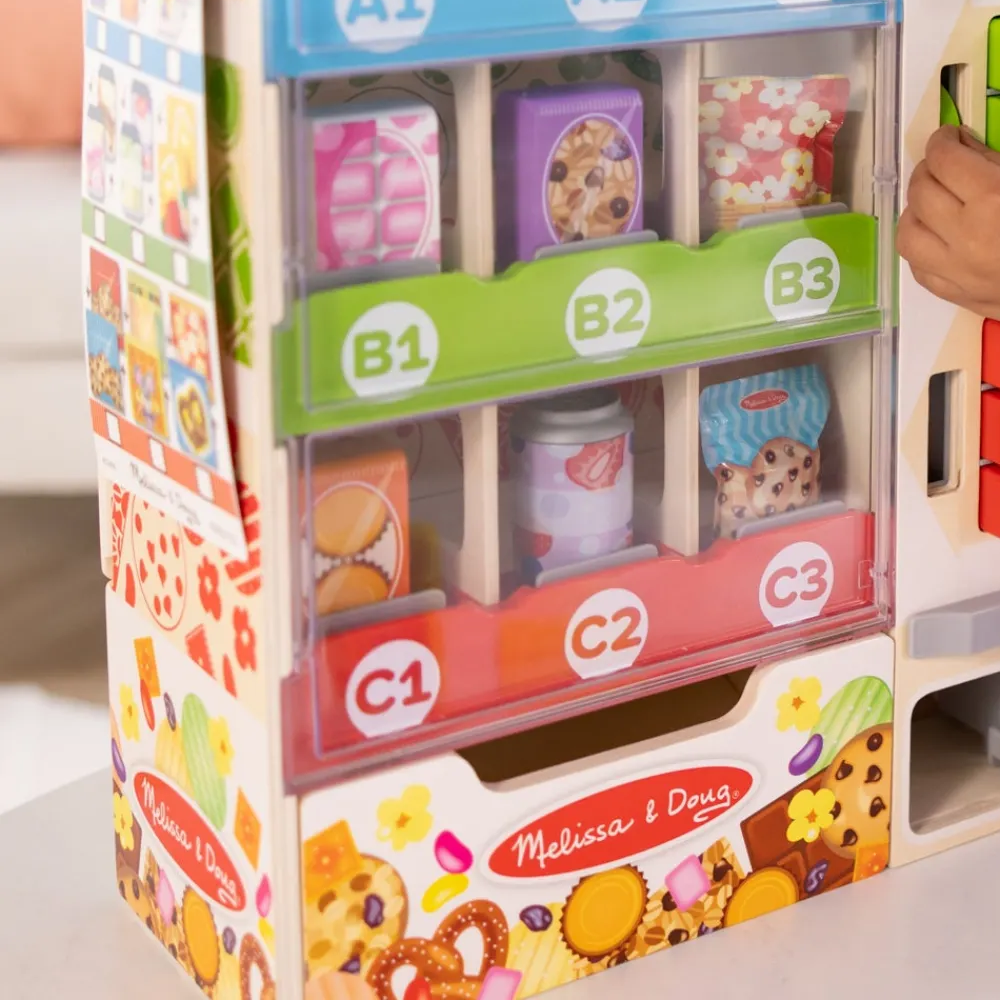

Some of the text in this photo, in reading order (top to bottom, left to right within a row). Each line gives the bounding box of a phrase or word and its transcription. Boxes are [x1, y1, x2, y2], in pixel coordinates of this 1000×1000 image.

[771, 257, 834, 307] B3
[573, 288, 645, 341] B2
[354, 324, 430, 379] B1
[765, 559, 828, 608] C3
[571, 607, 642, 660] C2
[355, 660, 432, 715] C1
[142, 777, 192, 850] Melissa
[205, 842, 241, 907] Doug
[511, 818, 634, 868] Melissa
[645, 799, 658, 824] &
